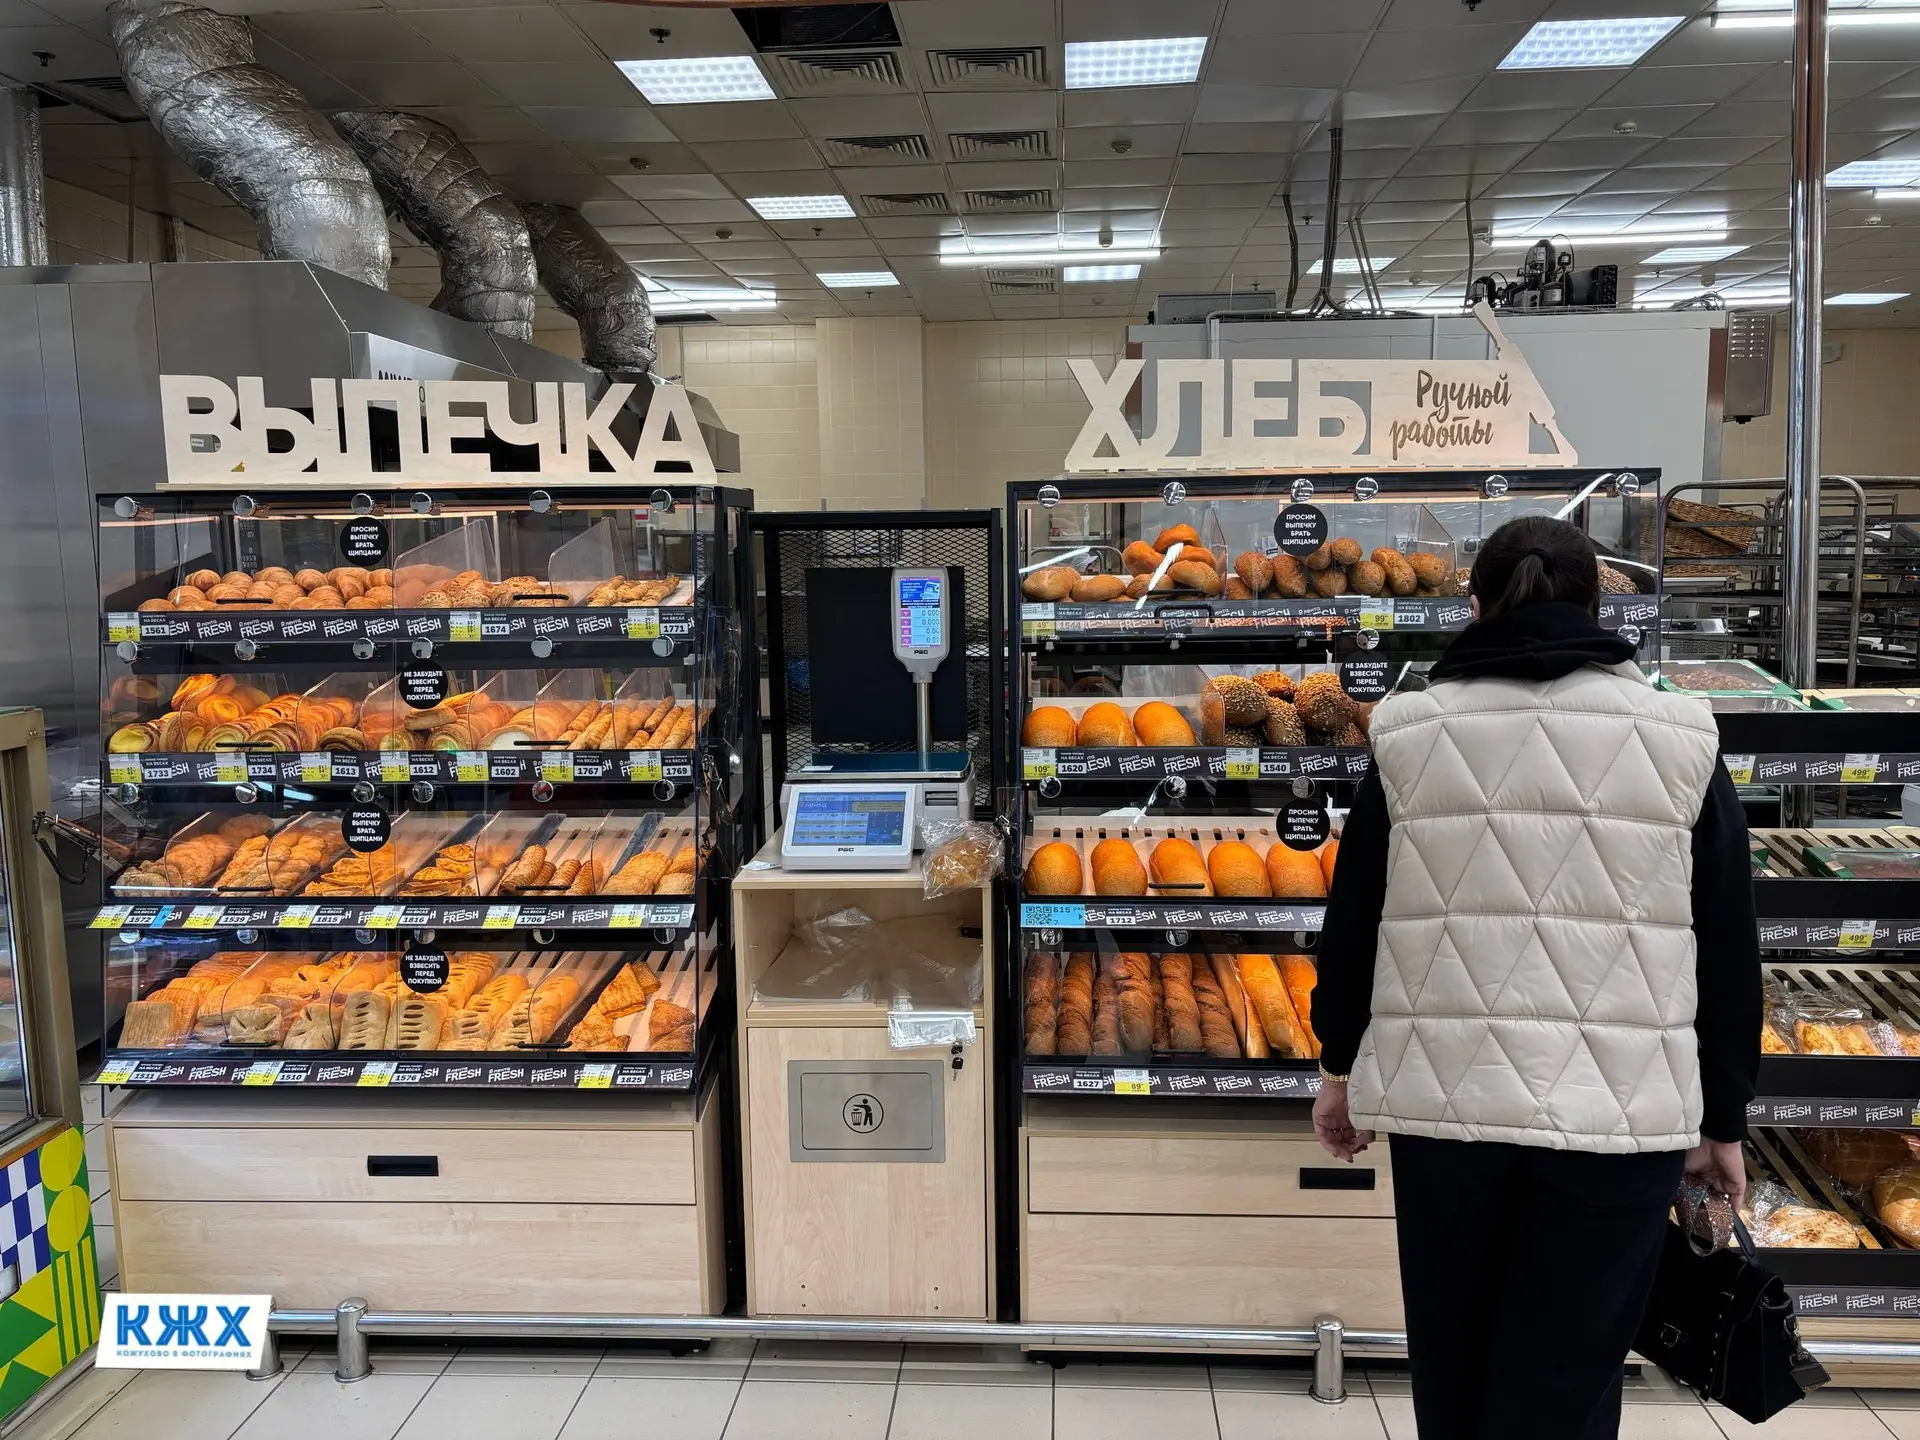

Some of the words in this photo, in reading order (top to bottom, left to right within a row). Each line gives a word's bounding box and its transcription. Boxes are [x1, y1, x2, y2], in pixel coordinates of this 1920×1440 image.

[1416, 369, 1513, 422] Ручной
[1065, 358, 1373, 468] ХЛЕБ
[159, 374, 717, 482] ВЫПЕЧКА
[1390, 412, 1494, 461] работы
[578, 616, 612, 634] FRESH
[1397, 614, 1422, 623] 1802
[144, 627, 167, 635] 1561
[170, 621, 190, 636] ESH
[198, 621, 232, 639] FRESH
[240, 620, 275, 638] FRESH
[283, 620, 317, 638] FRESH
[324, 620, 358, 638] FRESH
[366, 619, 400, 636] FRESH
[408, 618, 441, 636] FRESH
[484, 625, 506, 634] 1674
[535, 617, 569, 635] FRESH
[663, 625, 685, 633] 1771
[413, 670, 442, 678] ЗАБУДЬТЕ
[1348, 685, 1386, 693] ПОКУПКОЙ
[412, 766, 435, 774] 1612
[577, 767, 600, 775] 1767
[666, 767, 688, 775] 1769
[1061, 764, 1084, 772] 1620
[1087, 756, 1111, 772] ESH
[1120, 756, 1155, 774] FRESH
[1164, 756, 1200, 774] FRESH
[1264, 764, 1287, 772] 1540
[1301, 756, 1337, 773] FRESH
[1347, 759, 1368, 773] FRE
[1760, 762, 1797, 778] FRESH
[1898, 764, 1920, 778] FRE
[147, 769, 170, 778] 1733
[334, 767, 356, 776] 1613
[494, 768, 517, 776] 1602
[443, 910, 479, 924] FRESH
[573, 910, 608, 924] FRESH
[1166, 910, 1202, 924] FRESH
[1211, 911, 1248, 924] FRESH
[1257, 912, 1294, 925] FRESH
[1303, 914, 1324, 926] FRE
[1761, 926, 1798, 942] FRESH
[1898, 929, 1920, 943] FRE
[161, 1067, 184, 1078] ESH
[189, 1067, 226, 1080] FRESH
[317, 1068, 354, 1081] FRESH
[446, 1068, 481, 1082] FRESH
[488, 1069, 524, 1082] FRESH
[531, 1069, 566, 1083] FRESH
[1034, 1074, 1070, 1088] FRESH
[1170, 1076, 1206, 1090] FRESH
[1215, 1076, 1252, 1091] FRESH
[1261, 1077, 1298, 1092] FRESH
[1774, 1106, 1811, 1120] FRESH
[1820, 1106, 1857, 1121] FRESH
[1866, 1107, 1903, 1122] FRESH
[1800, 1294, 1837, 1310] FRESH
[1847, 1295, 1884, 1310] FRESH
